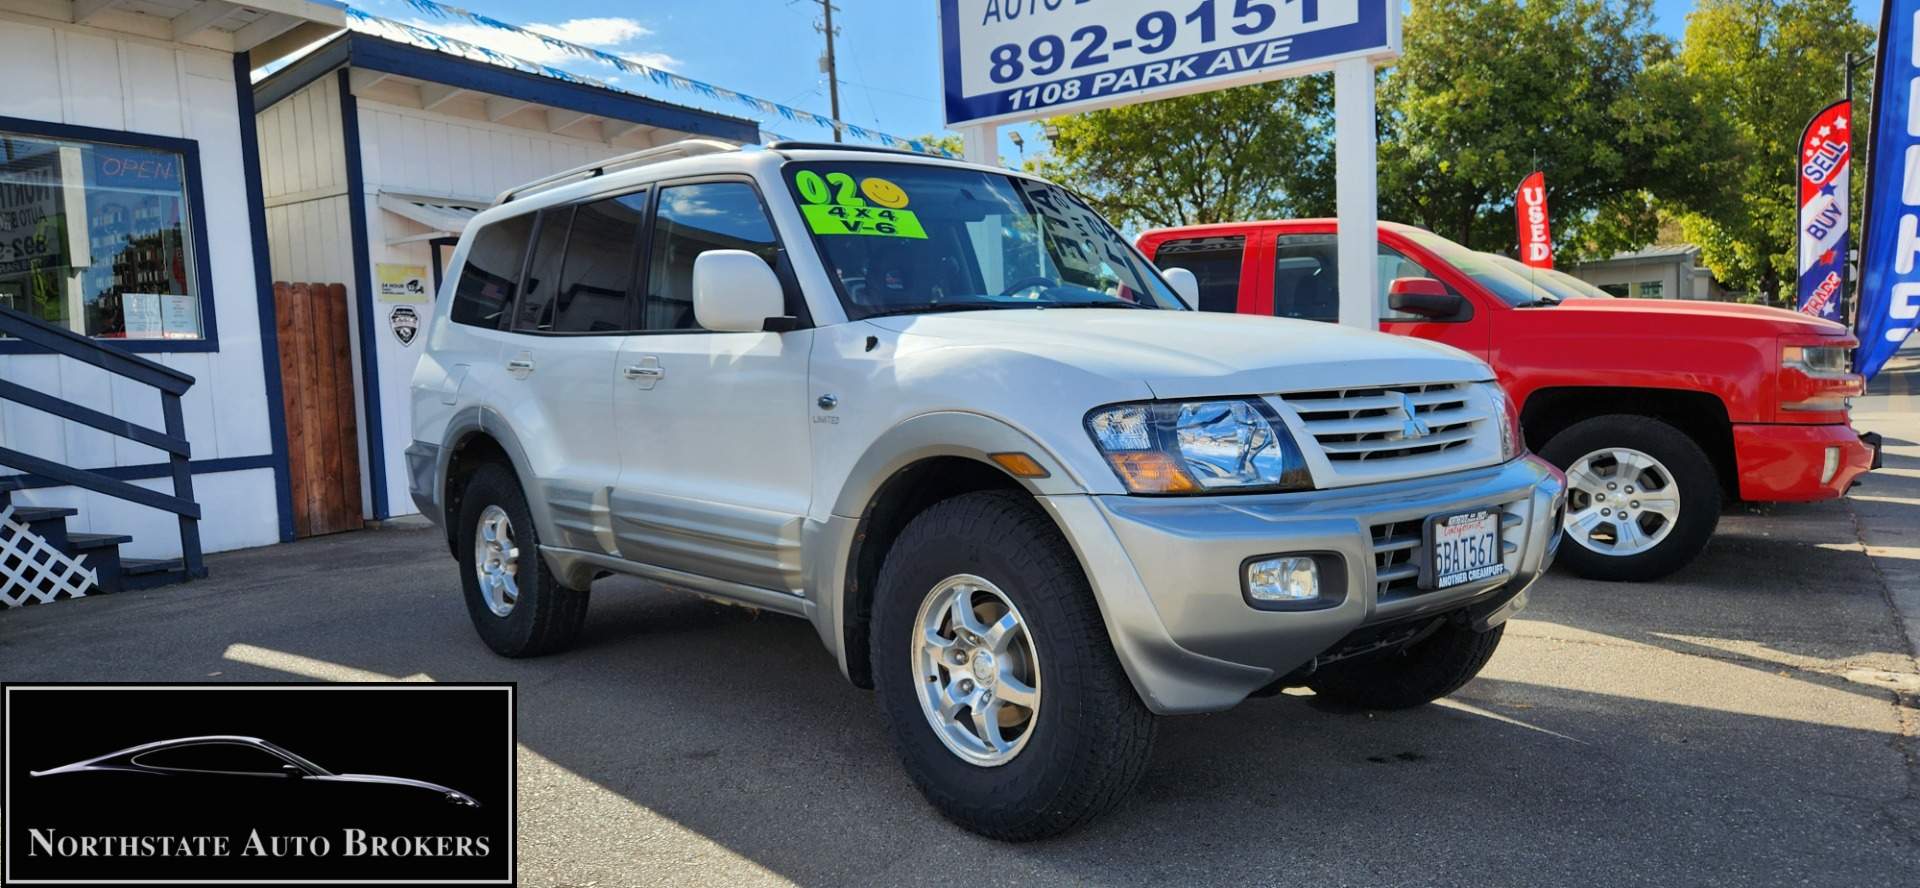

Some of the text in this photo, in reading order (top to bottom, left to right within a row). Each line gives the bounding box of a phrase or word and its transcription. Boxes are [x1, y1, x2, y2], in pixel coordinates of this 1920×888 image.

[989, 0, 1318, 84] 892-9151
[1008, 38, 1293, 110] 1108 PARK AVE
[103, 158, 172, 178] OPEN
[1804, 140, 1848, 185] SELL
[796, 170, 866, 207] 02
[841, 219, 897, 234] V-6
[1523, 186, 1550, 262] USED
[1806, 203, 1843, 241] BUY
[1439, 563, 1505, 589] ANOTHER CREAMPUFF
